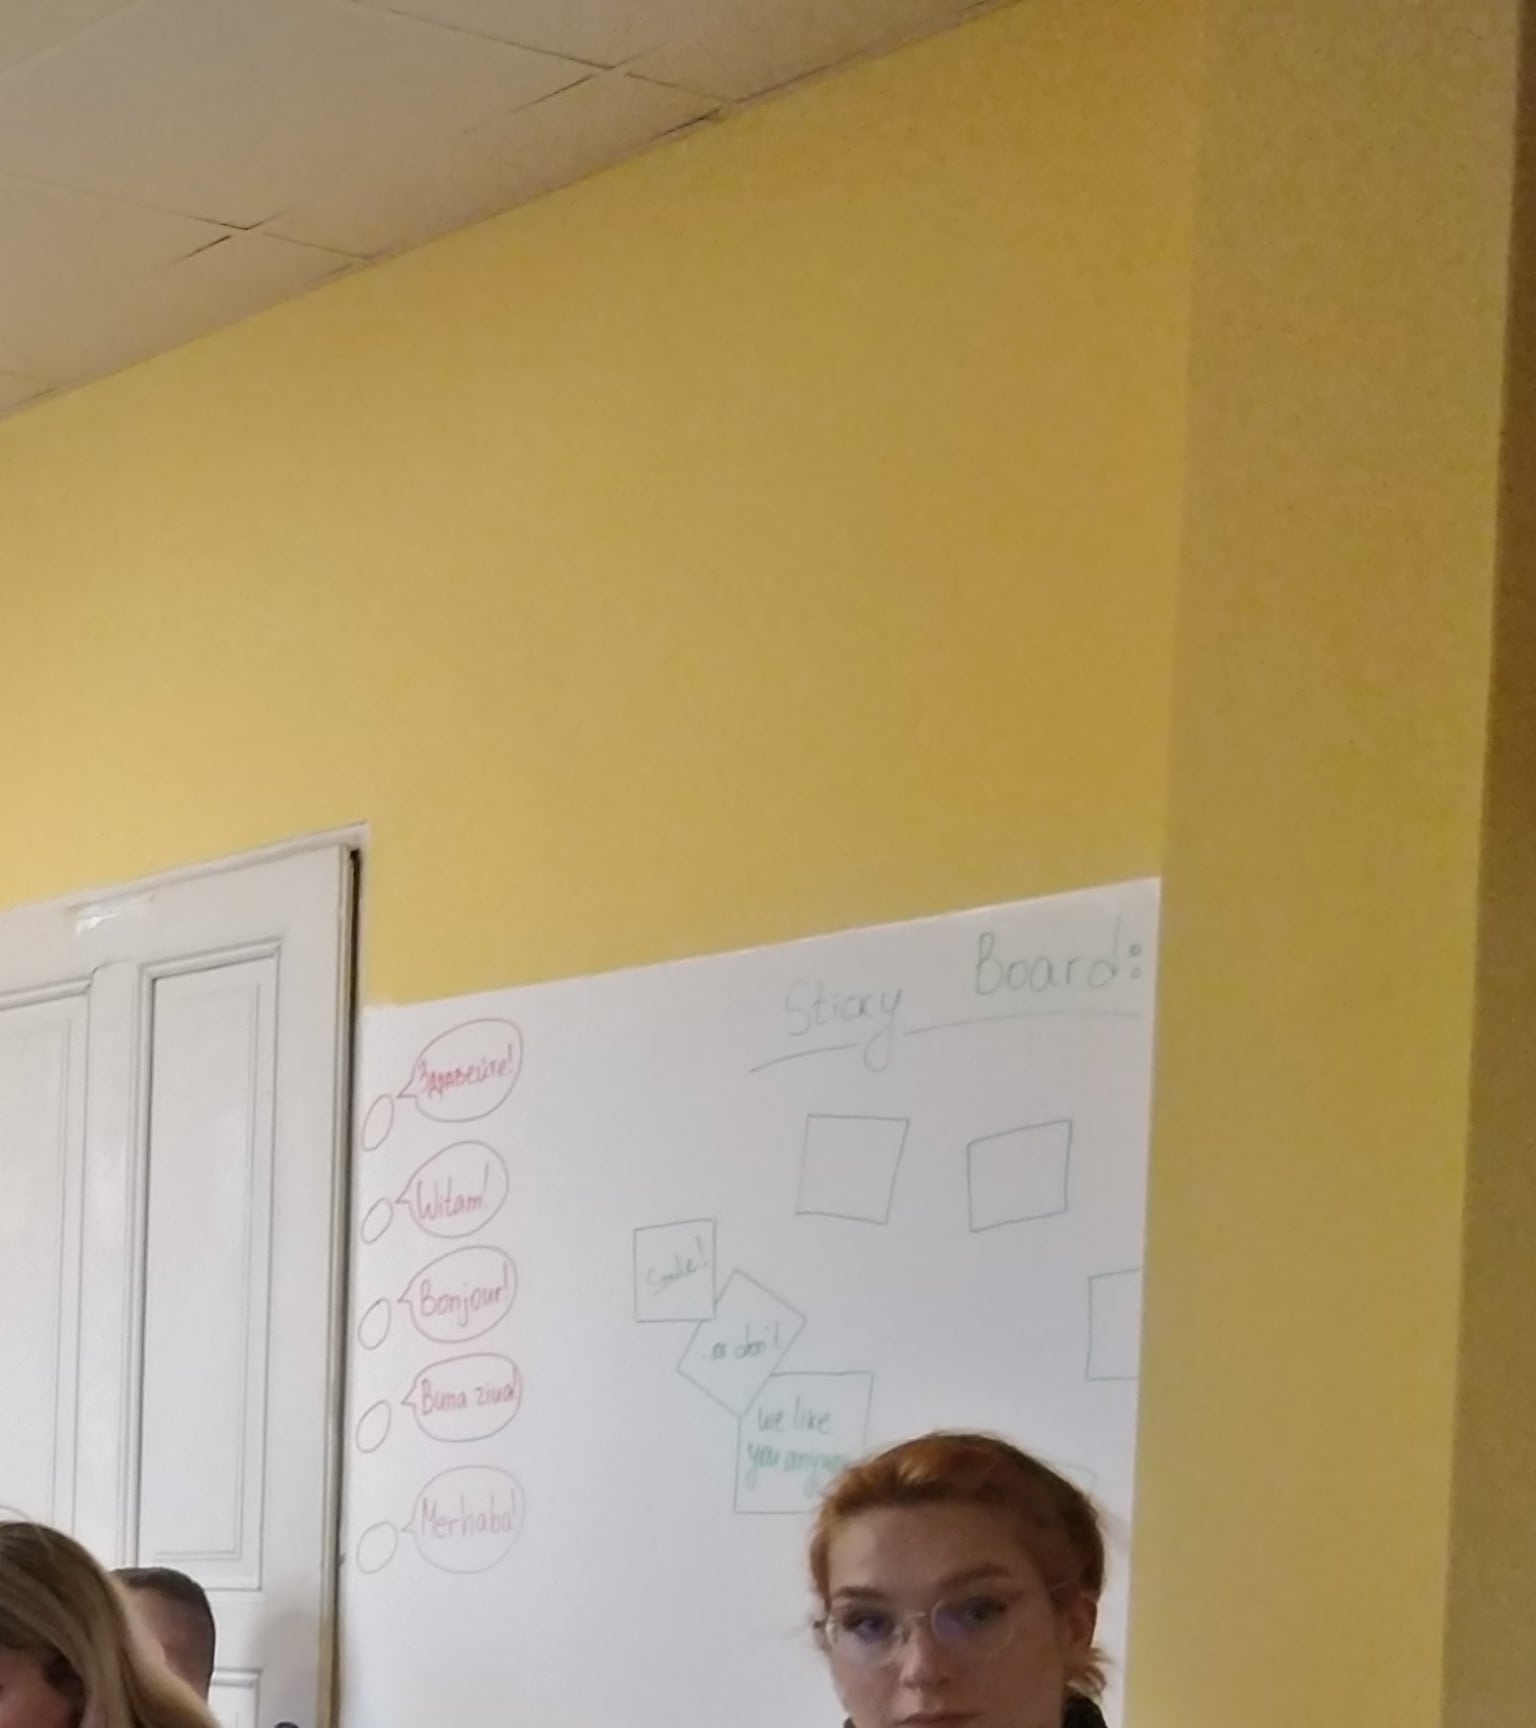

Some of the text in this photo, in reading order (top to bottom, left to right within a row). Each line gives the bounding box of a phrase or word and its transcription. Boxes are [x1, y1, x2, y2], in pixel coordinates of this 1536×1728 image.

[785, 910, 1144, 1072] Sticky Board:
[419, 1259, 508, 1329] Bonjour!
